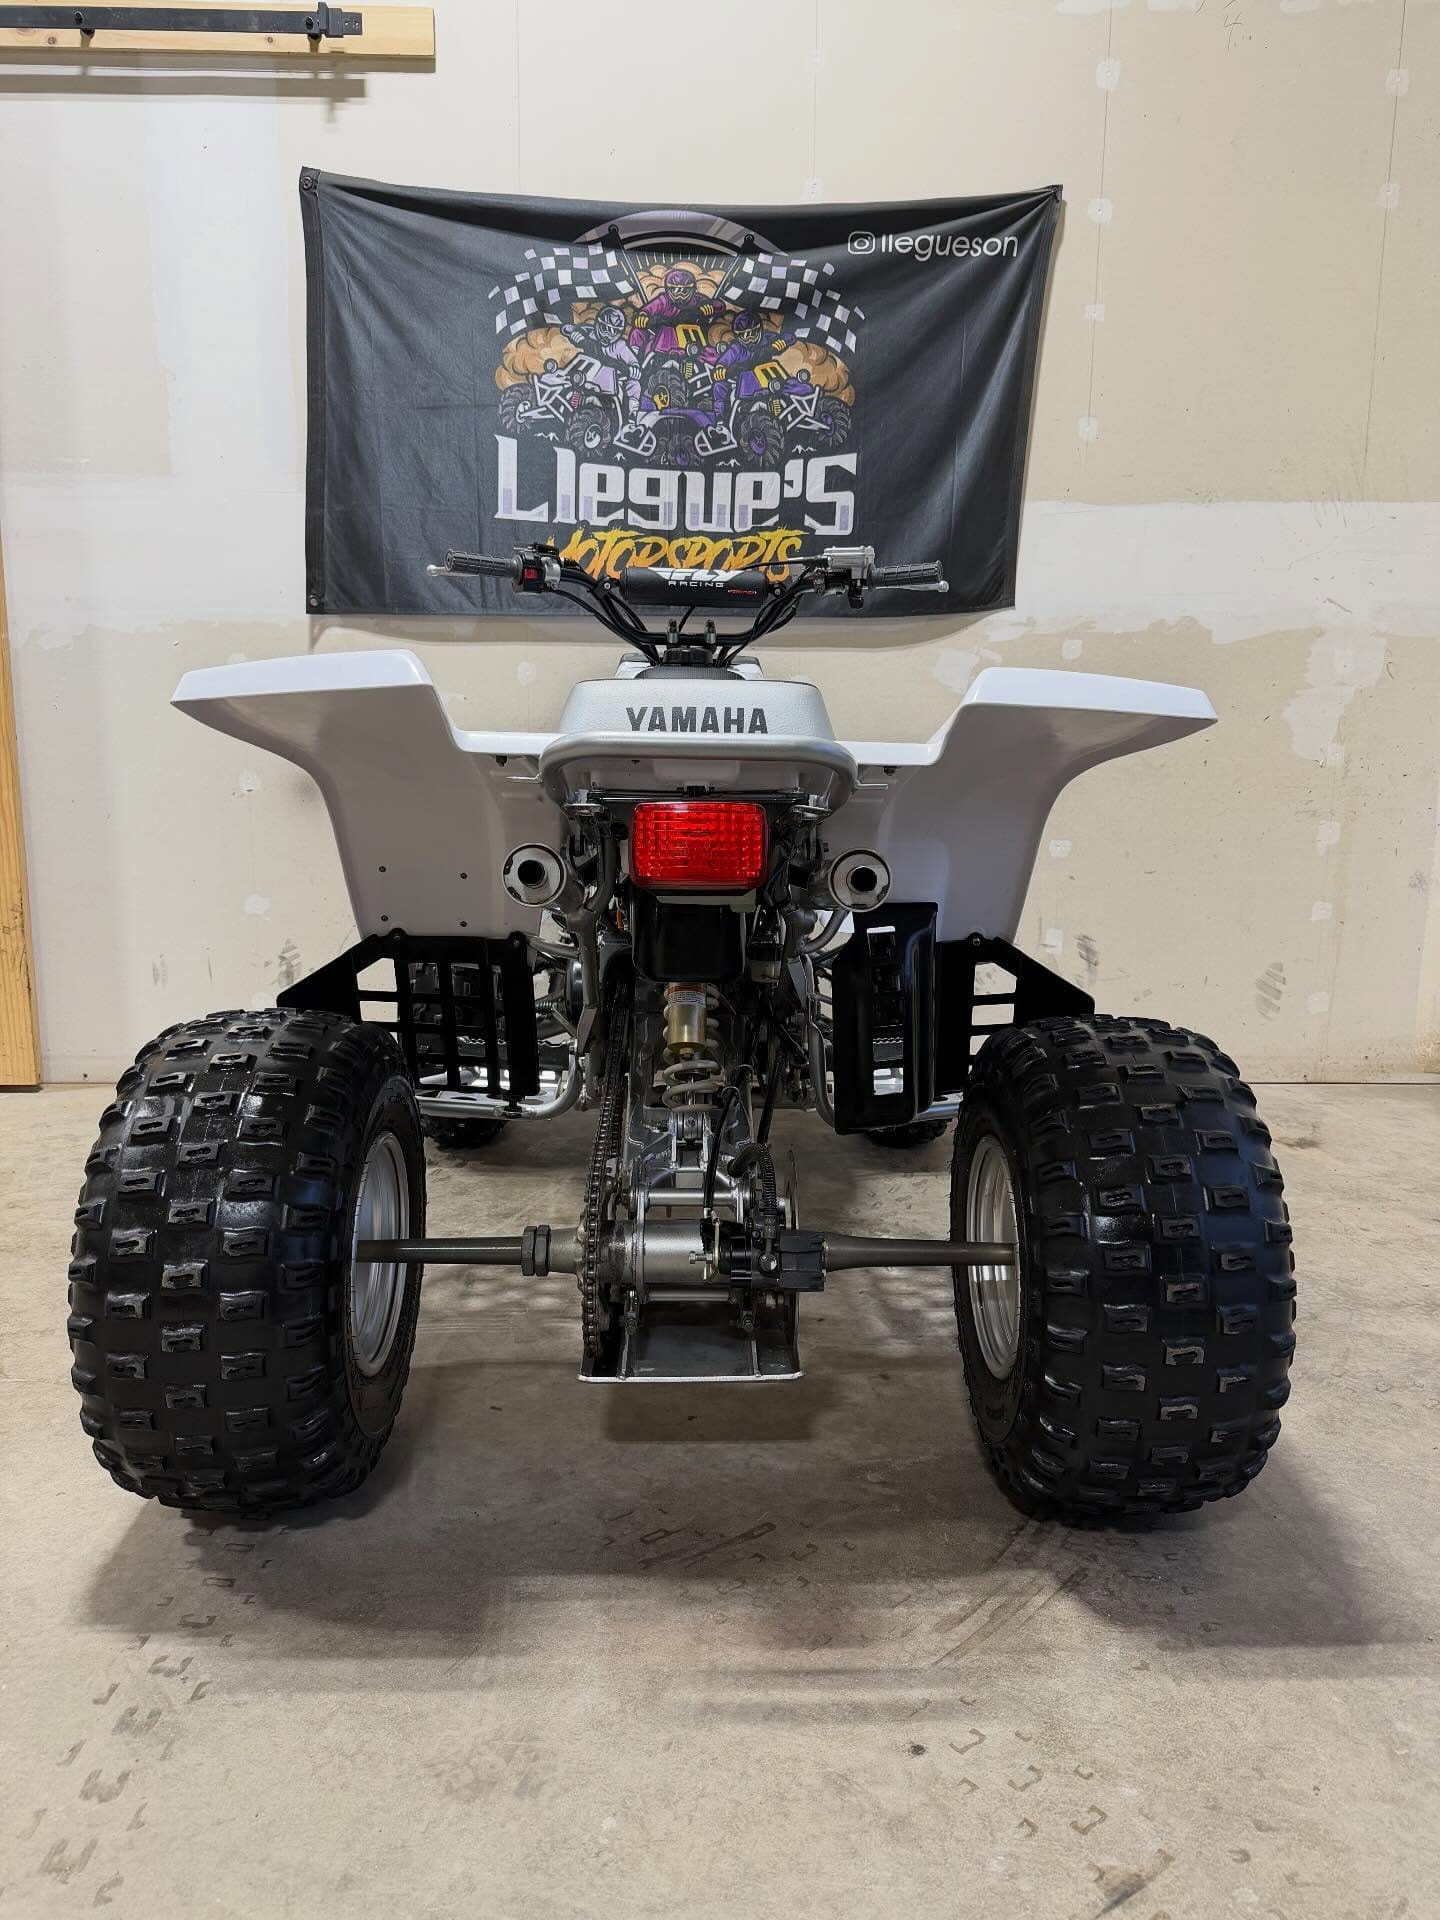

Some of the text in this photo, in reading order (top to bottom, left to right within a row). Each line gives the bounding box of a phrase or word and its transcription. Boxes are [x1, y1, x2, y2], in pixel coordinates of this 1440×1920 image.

[881, 233, 1019, 262] llegueson
[667, 580, 725, 588] RACING
[625, 706, 769, 734] YAMAHA
